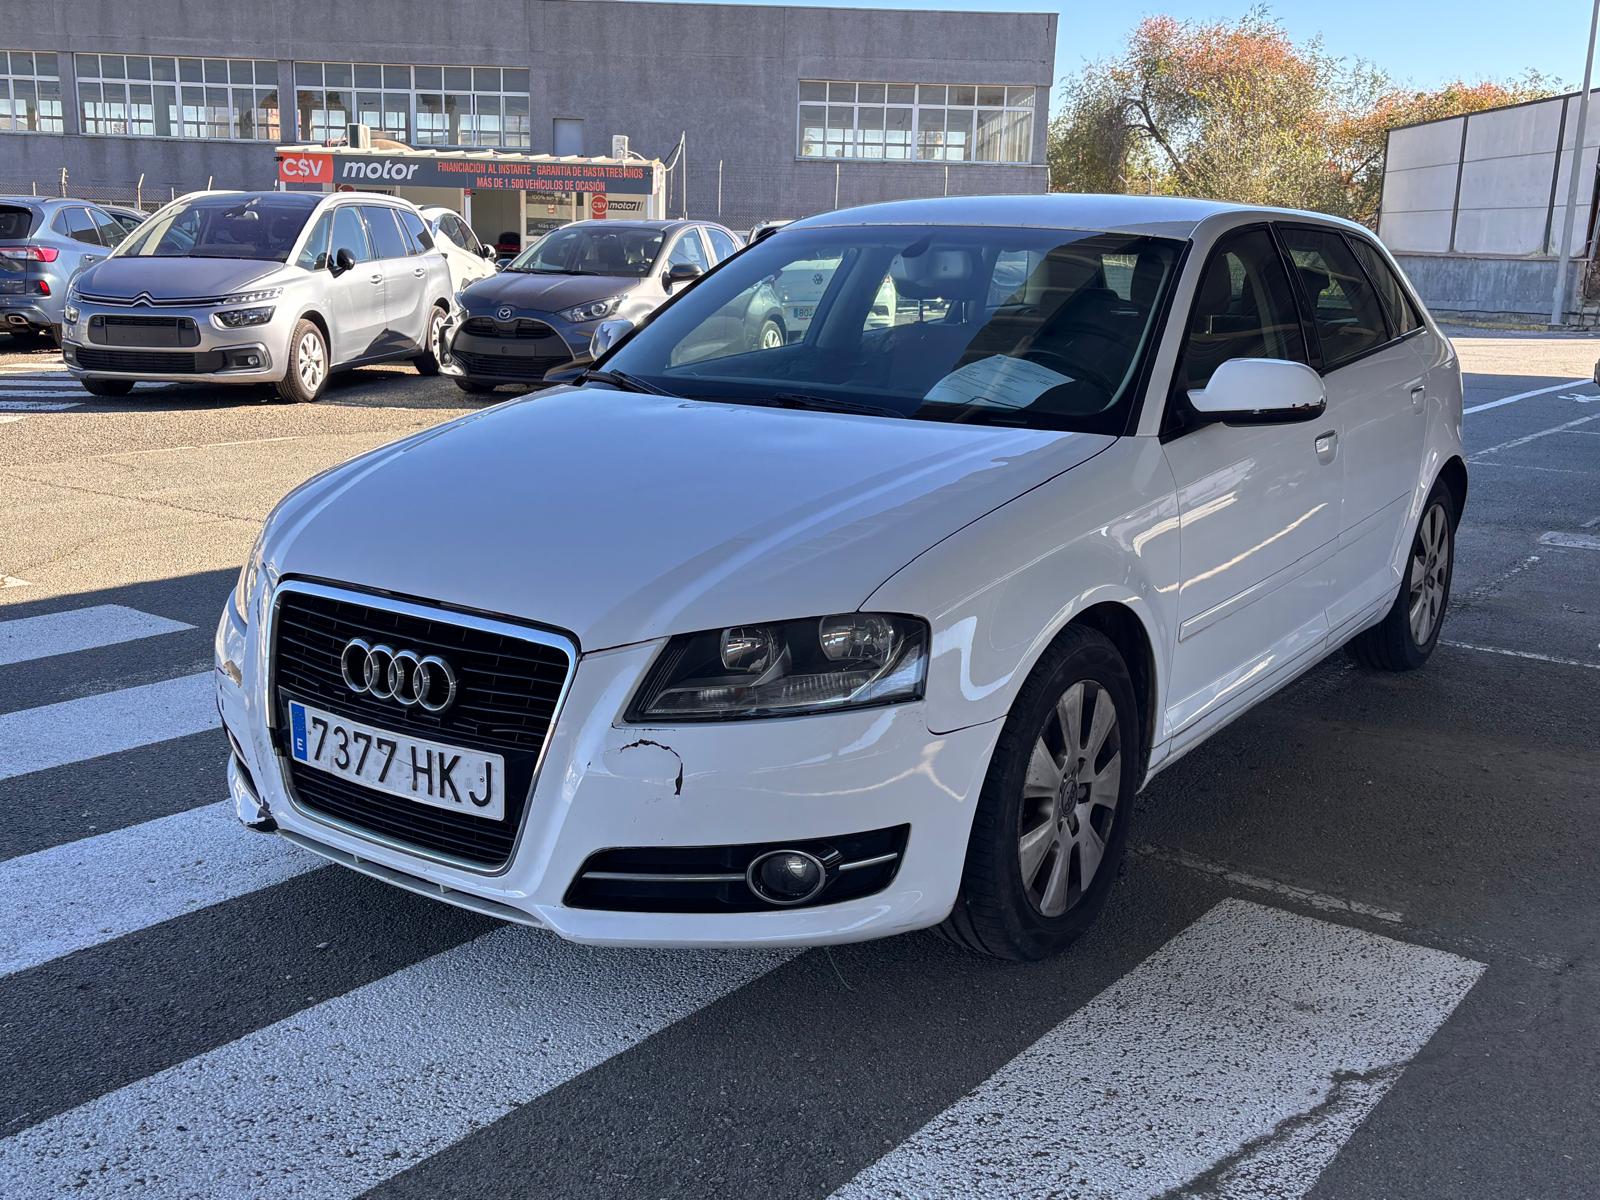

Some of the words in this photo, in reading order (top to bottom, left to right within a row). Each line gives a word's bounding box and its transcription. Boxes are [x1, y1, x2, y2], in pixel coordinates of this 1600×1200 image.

[282, 158, 323, 177] CSV
[342, 160, 419, 180] motor
[488, 164, 497, 174] AL
[498, 164, 531, 175] INSTANTE
[572, 166, 582, 177] DE
[583, 166, 605, 178] HASTA
[606, 167, 623, 178] TRES
[476, 175, 492, 188] MÁS
[493, 178, 503, 188] DE
[525, 177, 563, 190] VEHÍCULOS
[564, 180, 574, 190] DE
[575, 179, 606, 192] OCASIÓN
[592, 201, 607, 209] CSV
[609, 201, 635, 210] motor
[297, 738, 304, 751] E
[312, 716, 397, 783] 7377
[411, 746, 492, 807] HKJ
